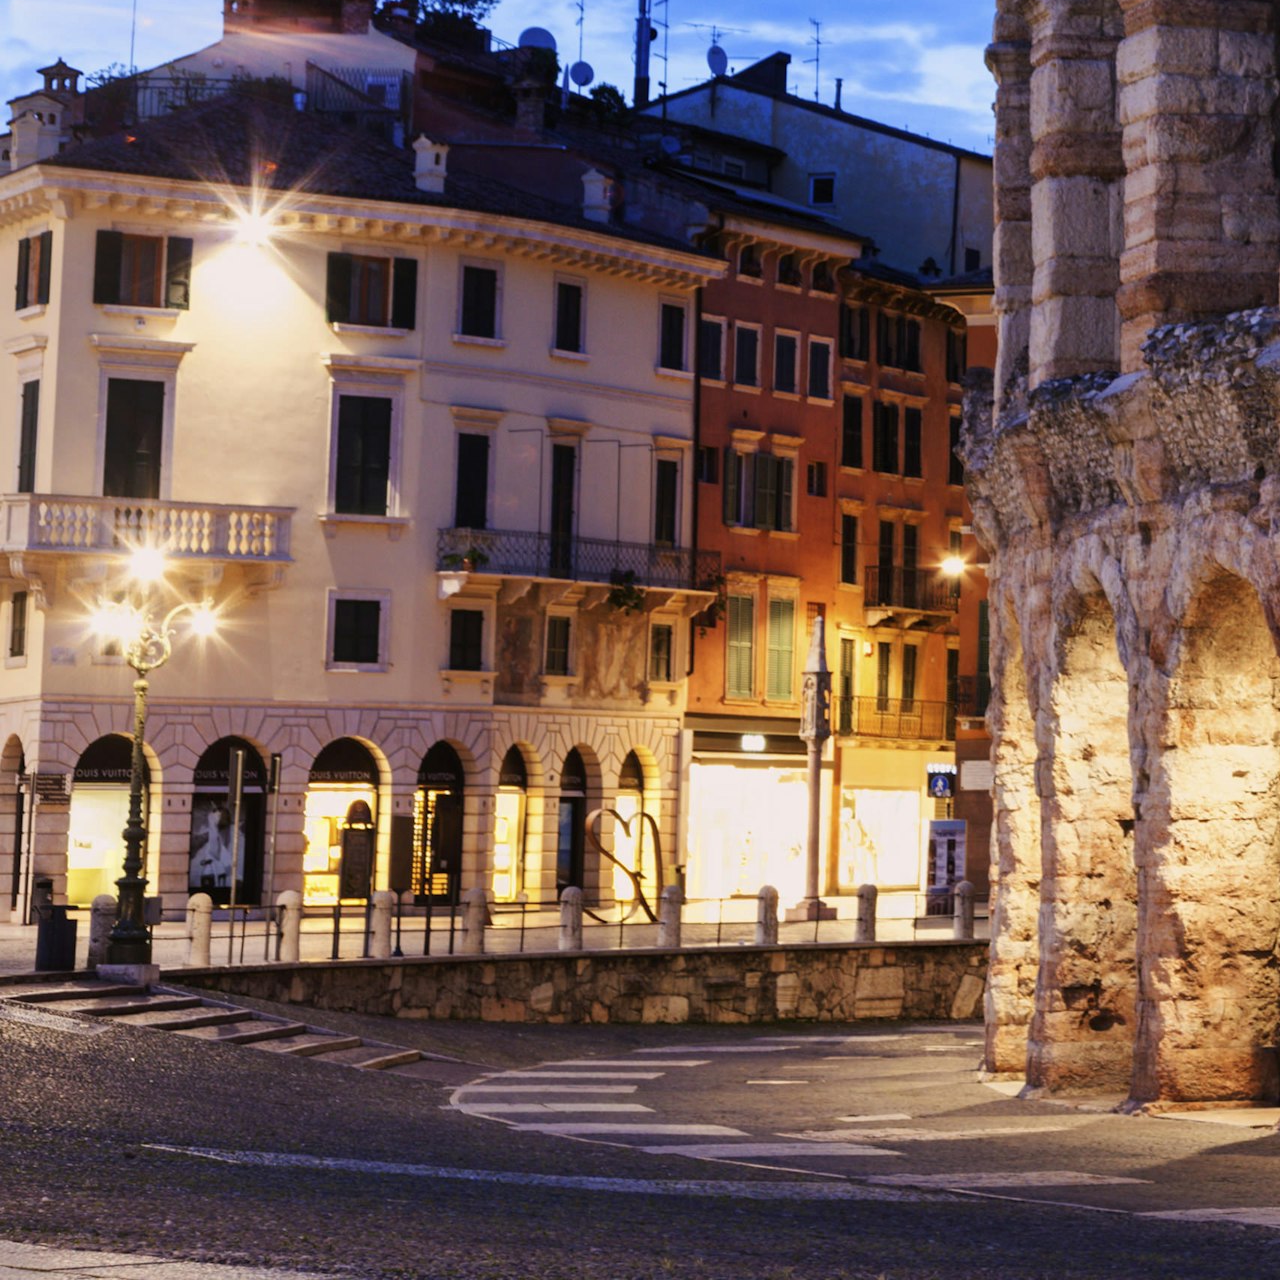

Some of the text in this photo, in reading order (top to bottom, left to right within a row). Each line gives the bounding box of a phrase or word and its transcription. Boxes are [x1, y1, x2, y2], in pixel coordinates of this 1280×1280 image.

[76, 768, 99, 778] OUIS
[101, 768, 133, 778] VUITTO
[195, 770, 217, 779] OUIS
[310, 771, 371, 779] OUIS VUITTON
